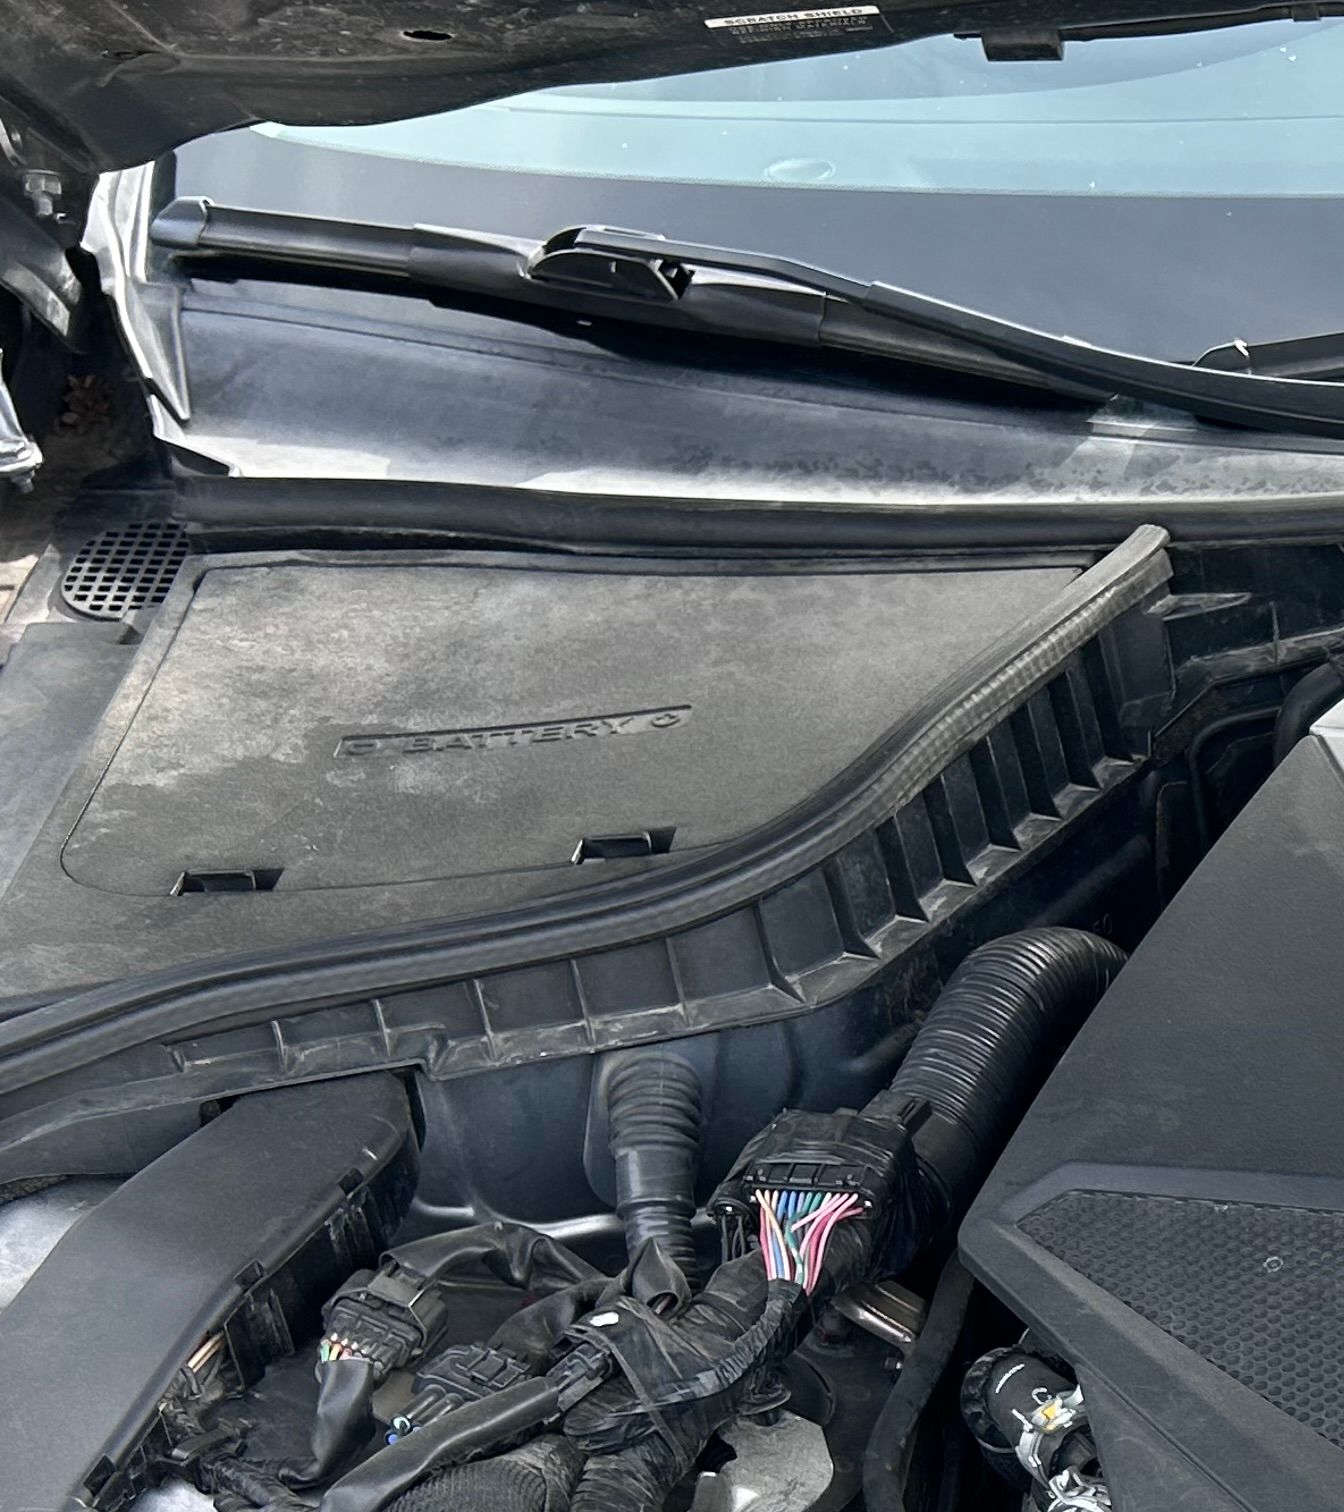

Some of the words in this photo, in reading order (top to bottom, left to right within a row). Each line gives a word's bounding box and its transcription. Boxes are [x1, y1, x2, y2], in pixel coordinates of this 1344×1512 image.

[724, 13, 799, 25] SCRATCH
[803, 8, 863, 18] SHIELD
[402, 716, 635, 754] BATTERY
